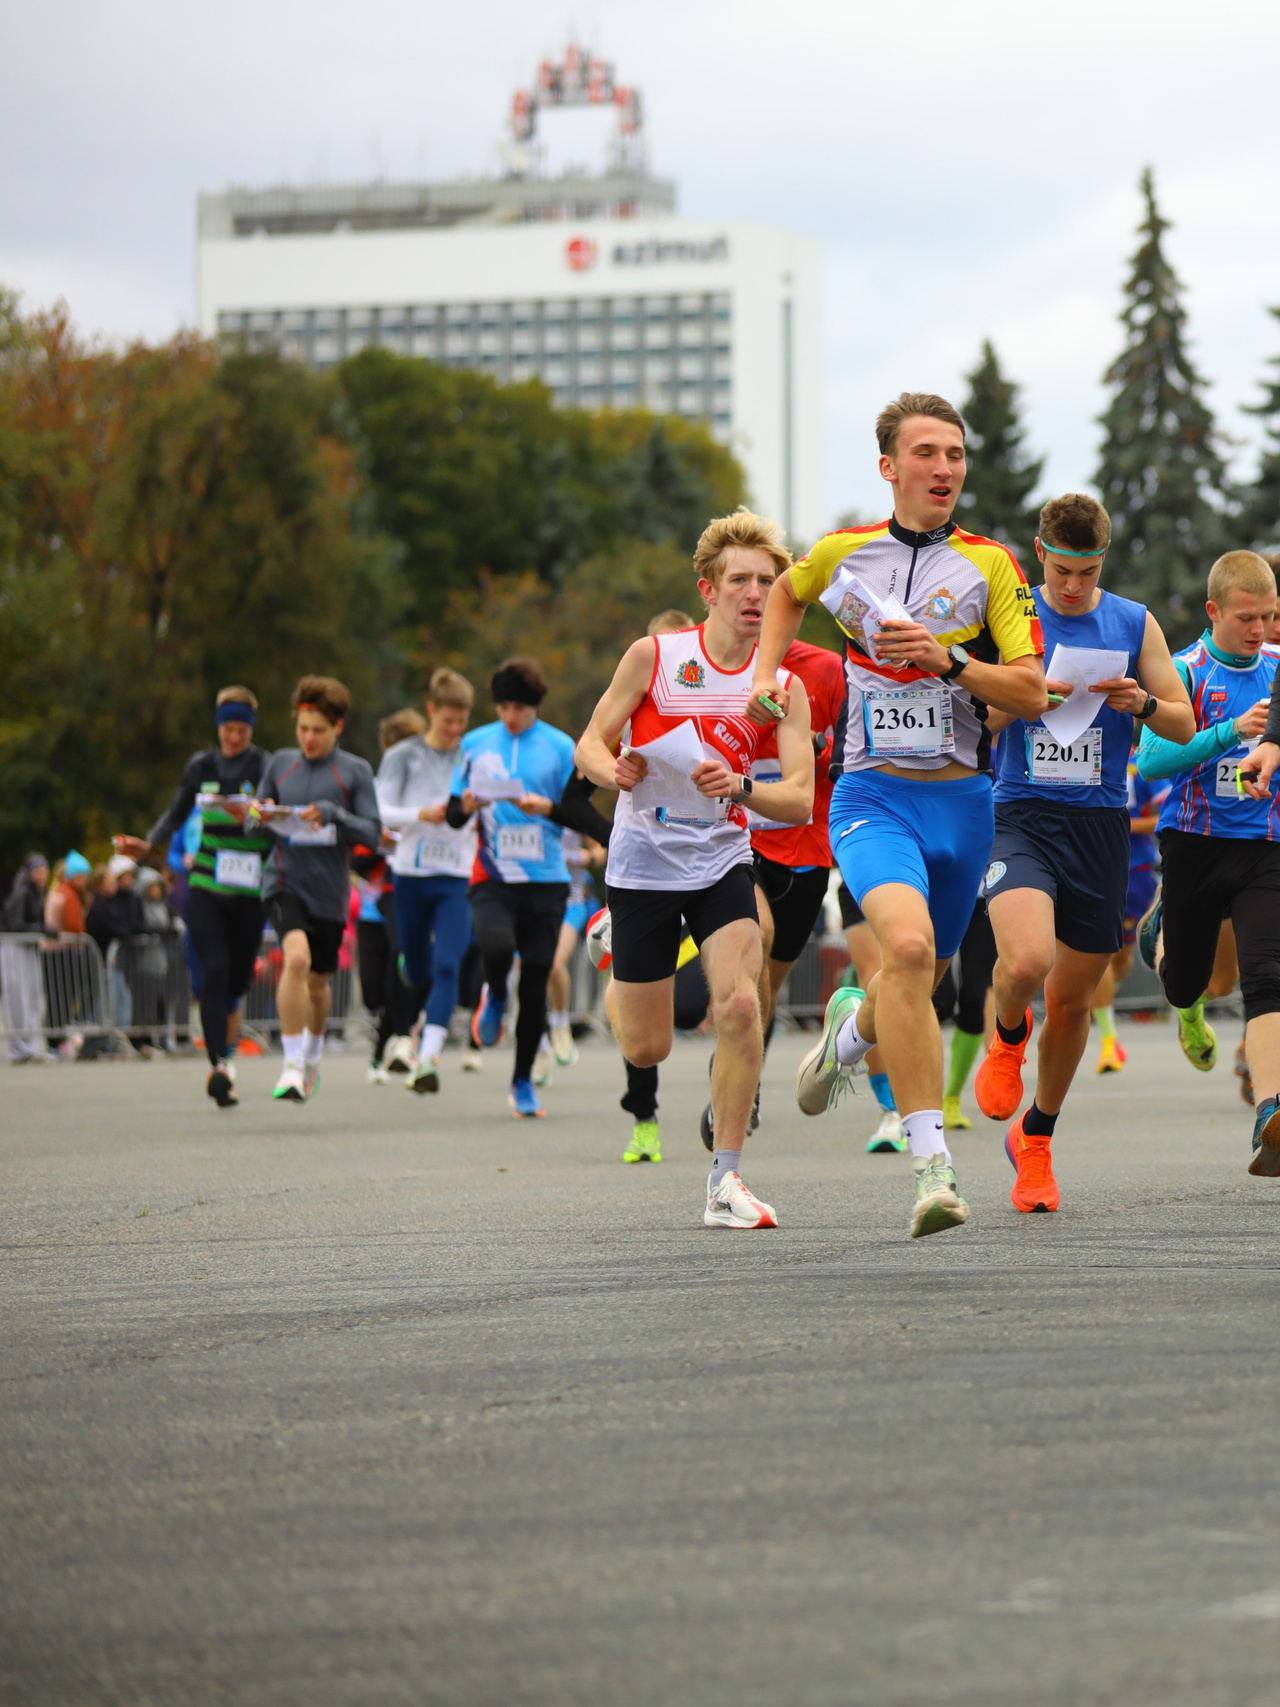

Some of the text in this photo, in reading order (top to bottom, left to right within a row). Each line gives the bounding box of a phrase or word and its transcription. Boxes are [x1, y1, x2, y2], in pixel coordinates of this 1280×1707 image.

[613, 232, 728, 265] azimut
[873, 706, 937, 730] 236.1
[713, 722, 741, 751] Run
[1035, 742, 1089, 763] 220.1
